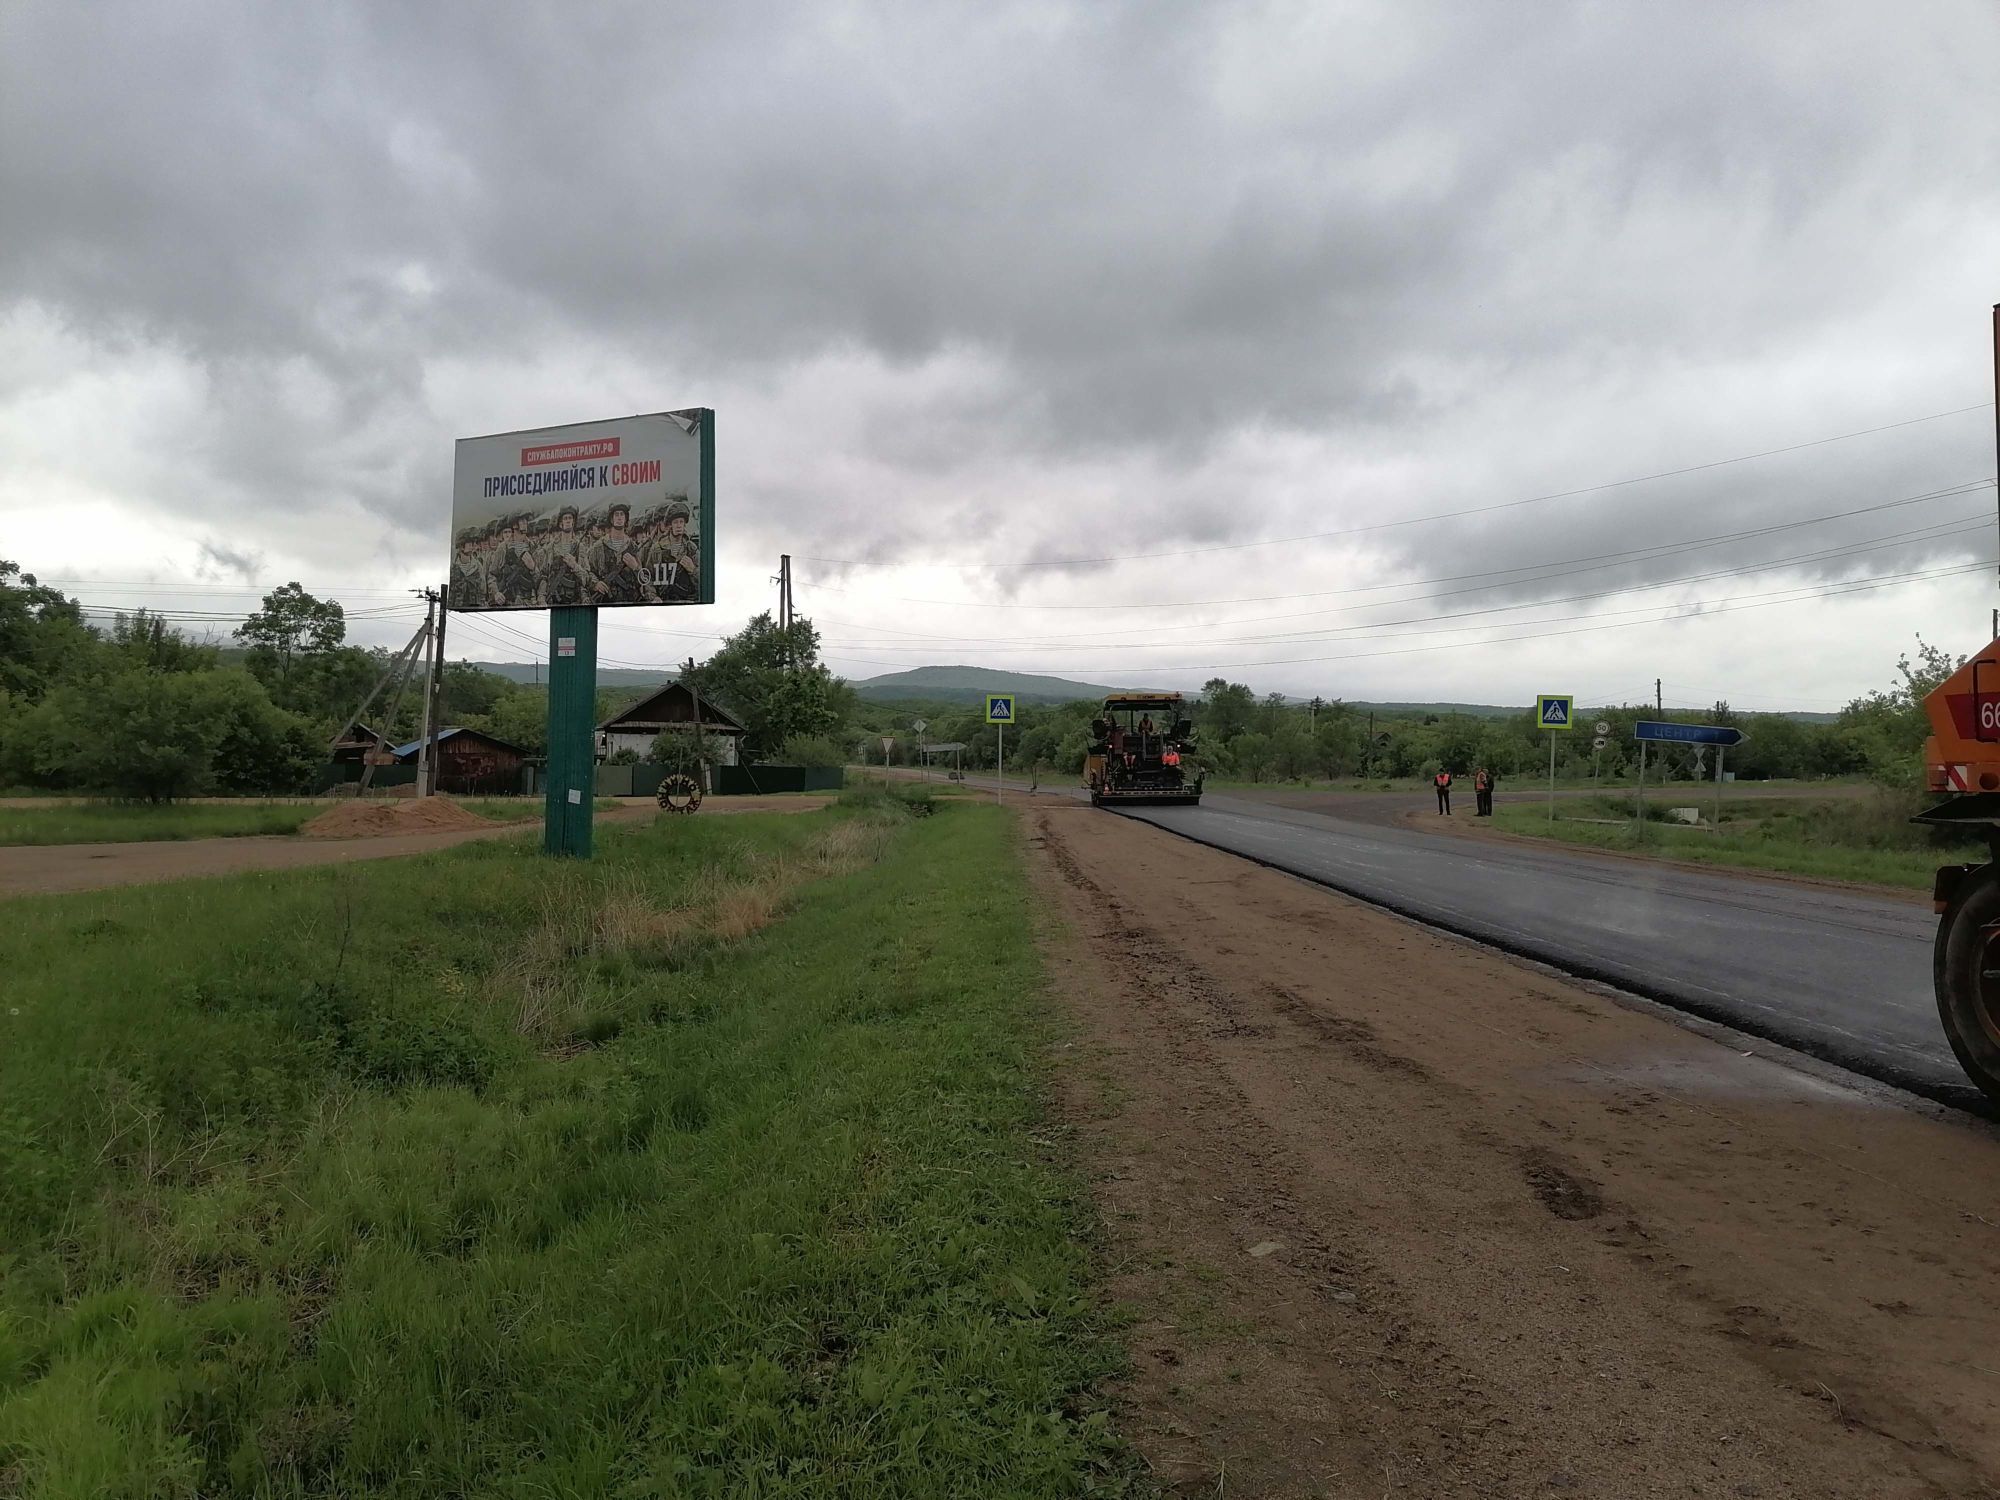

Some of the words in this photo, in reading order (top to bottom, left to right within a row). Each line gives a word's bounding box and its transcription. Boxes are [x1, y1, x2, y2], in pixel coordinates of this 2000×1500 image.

[527, 442, 614, 462] СЛУЖБАПОКОНТРАКТУ.РФ
[484, 463, 595, 498] ПРИСОЕДИНЯЙСЯ
[599, 465, 608, 487] К
[612, 460, 661, 486] СВОИМ
[653, 563, 677, 585] 117
[1654, 727, 1702, 739] ЦЕНТР
